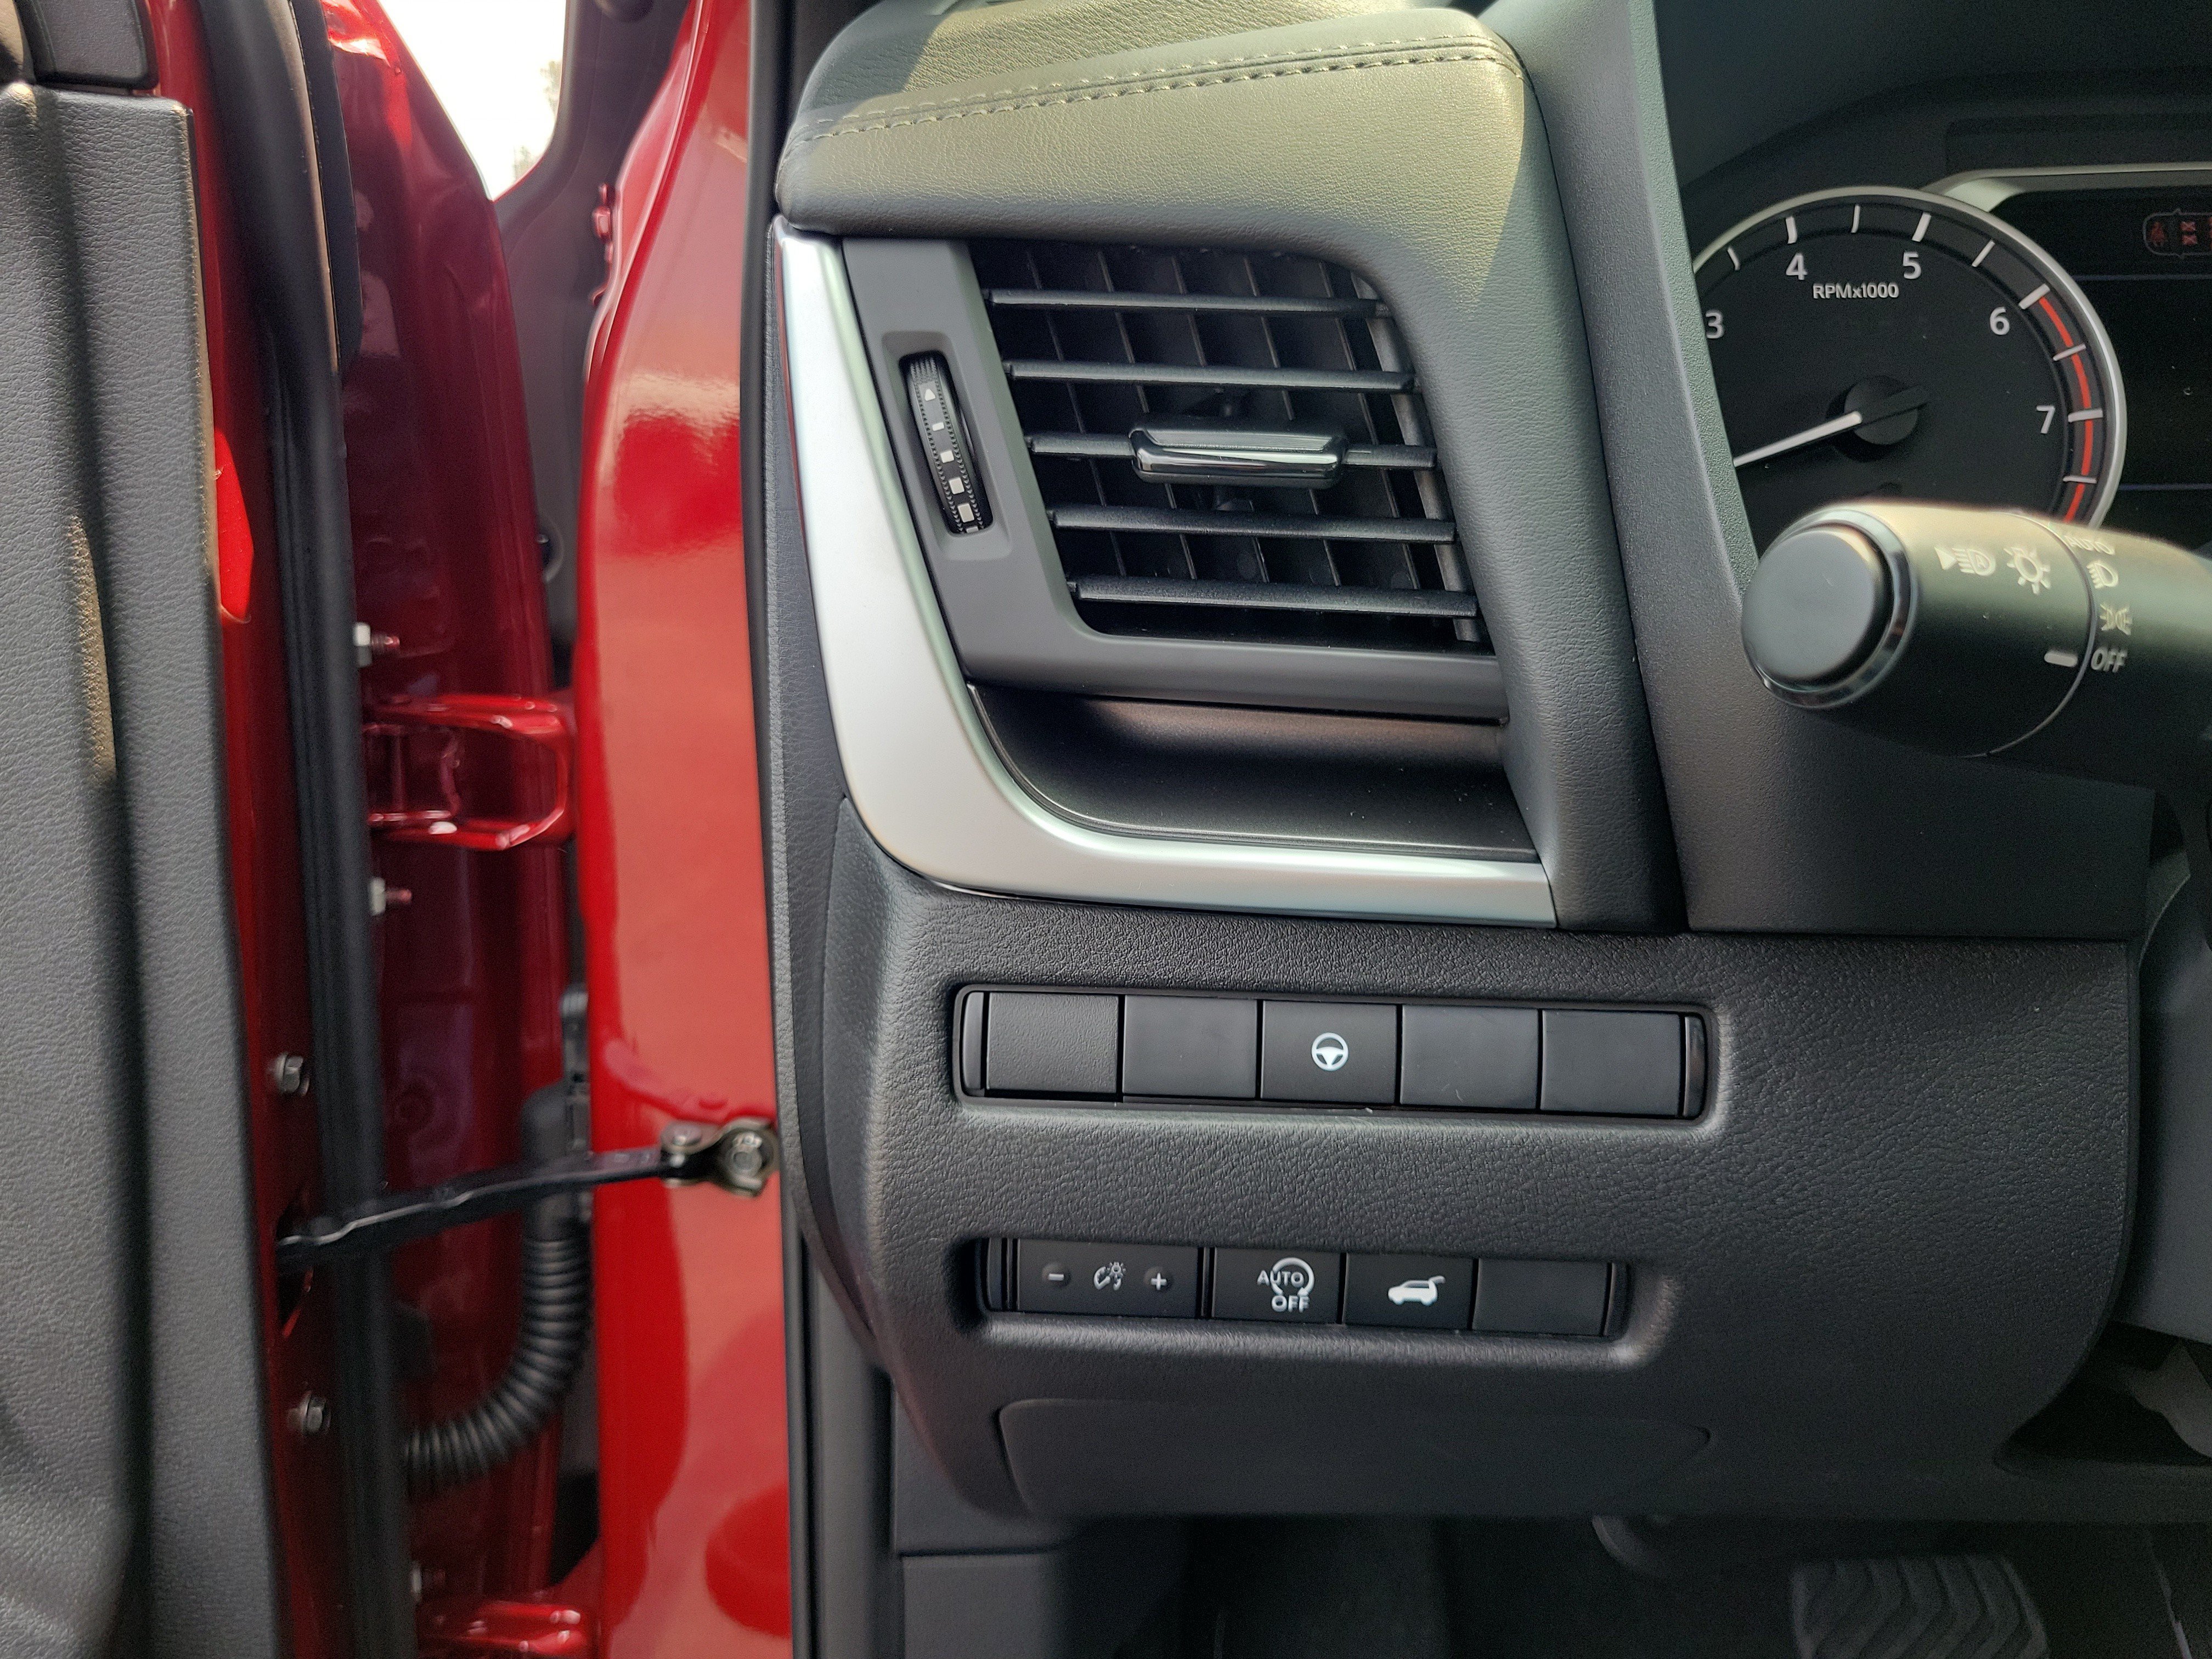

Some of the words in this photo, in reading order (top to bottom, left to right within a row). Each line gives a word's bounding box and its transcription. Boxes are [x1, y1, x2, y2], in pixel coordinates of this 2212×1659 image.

[1786, 253, 1808, 280] 4
[1903, 251, 1921, 279] 5
[1813, 282, 1899, 299] RPMx1000
[1705, 309, 1724, 338] 3
[1989, 307, 2010, 335] 6
[2036, 405, 2056, 434] 7
[2063, 535, 2115, 555] AUTO
[2091, 646, 2128, 673] OFF
[1257, 1270, 1305, 1288] AUTO
[1272, 1295, 1310, 1313] OFF
